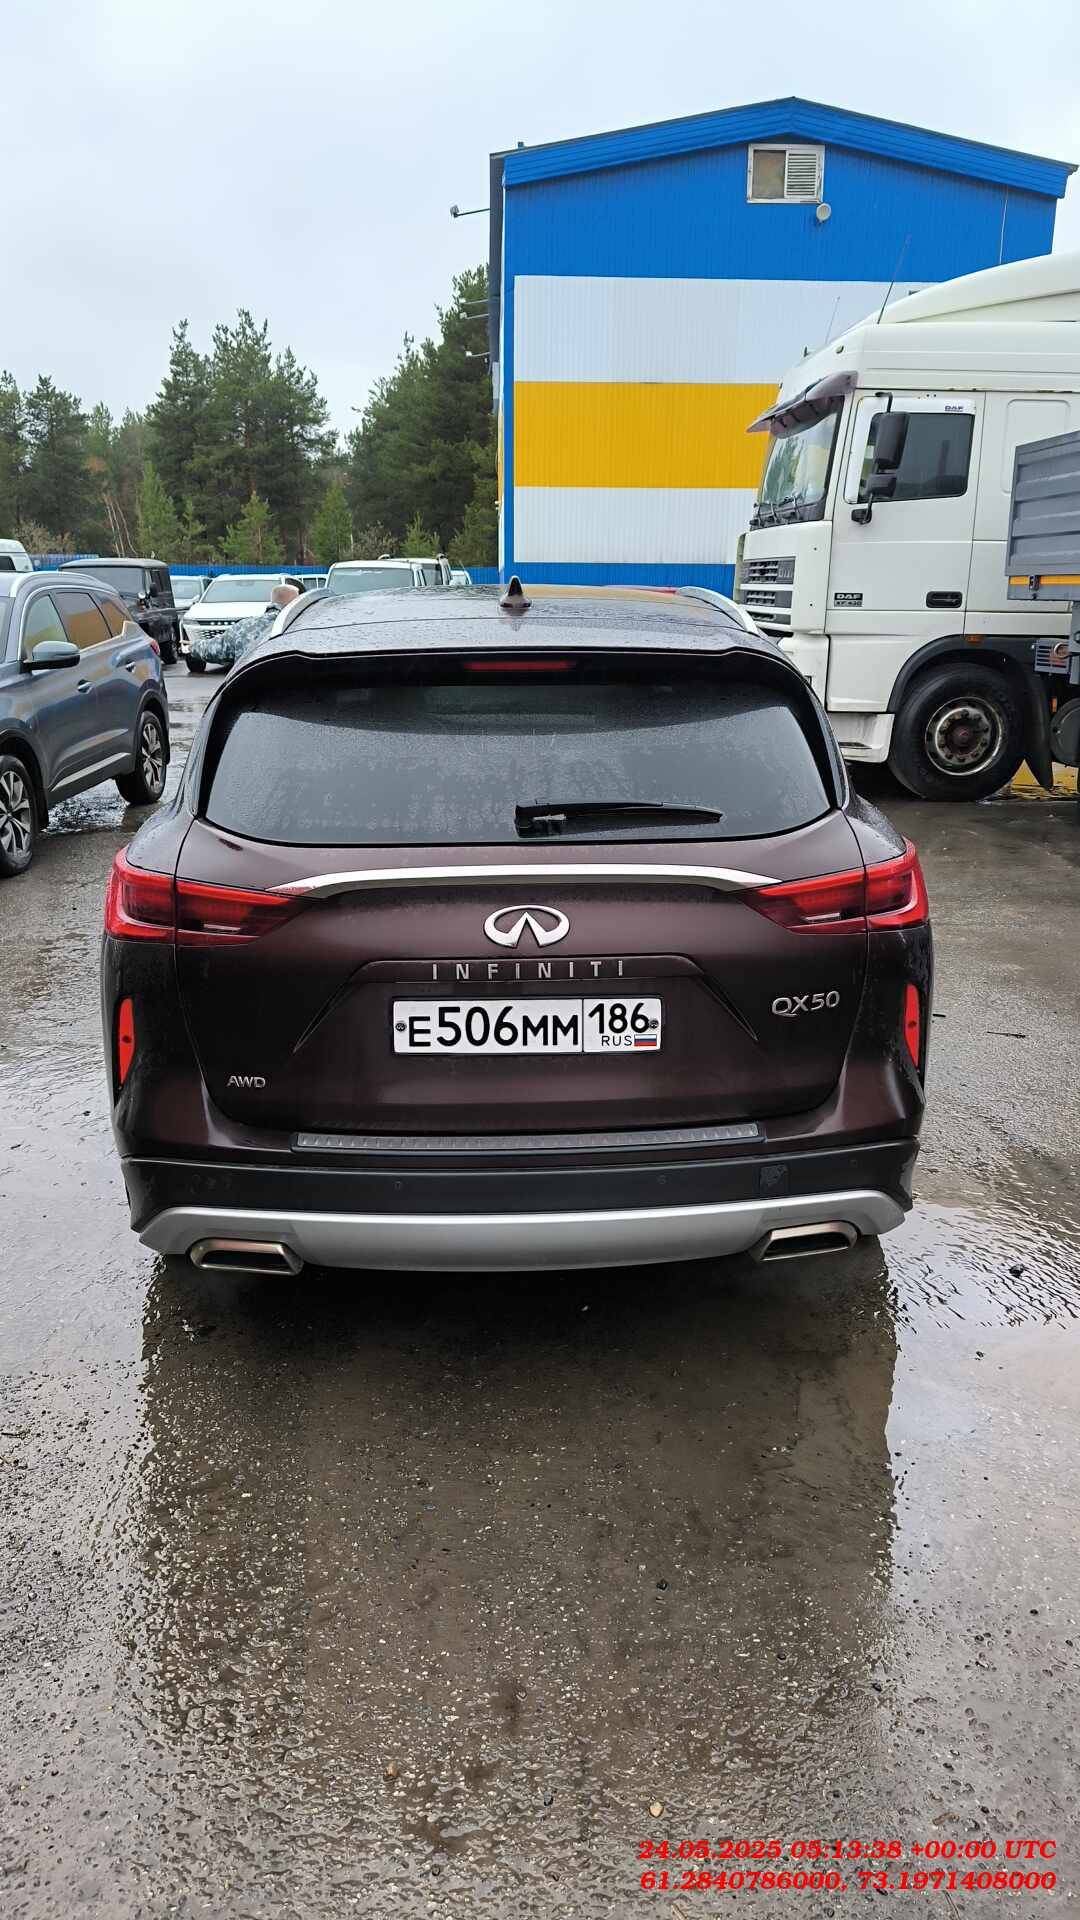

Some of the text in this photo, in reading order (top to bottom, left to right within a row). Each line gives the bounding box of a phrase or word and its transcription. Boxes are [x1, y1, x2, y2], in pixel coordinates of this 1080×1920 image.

[432, 960, 623, 981] INFINITI
[772, 990, 840, 1017] QX50
[588, 1002, 650, 1034] 186
[601, 1035, 633, 1047] RUS
[227, 1075, 266, 1088] AWD
